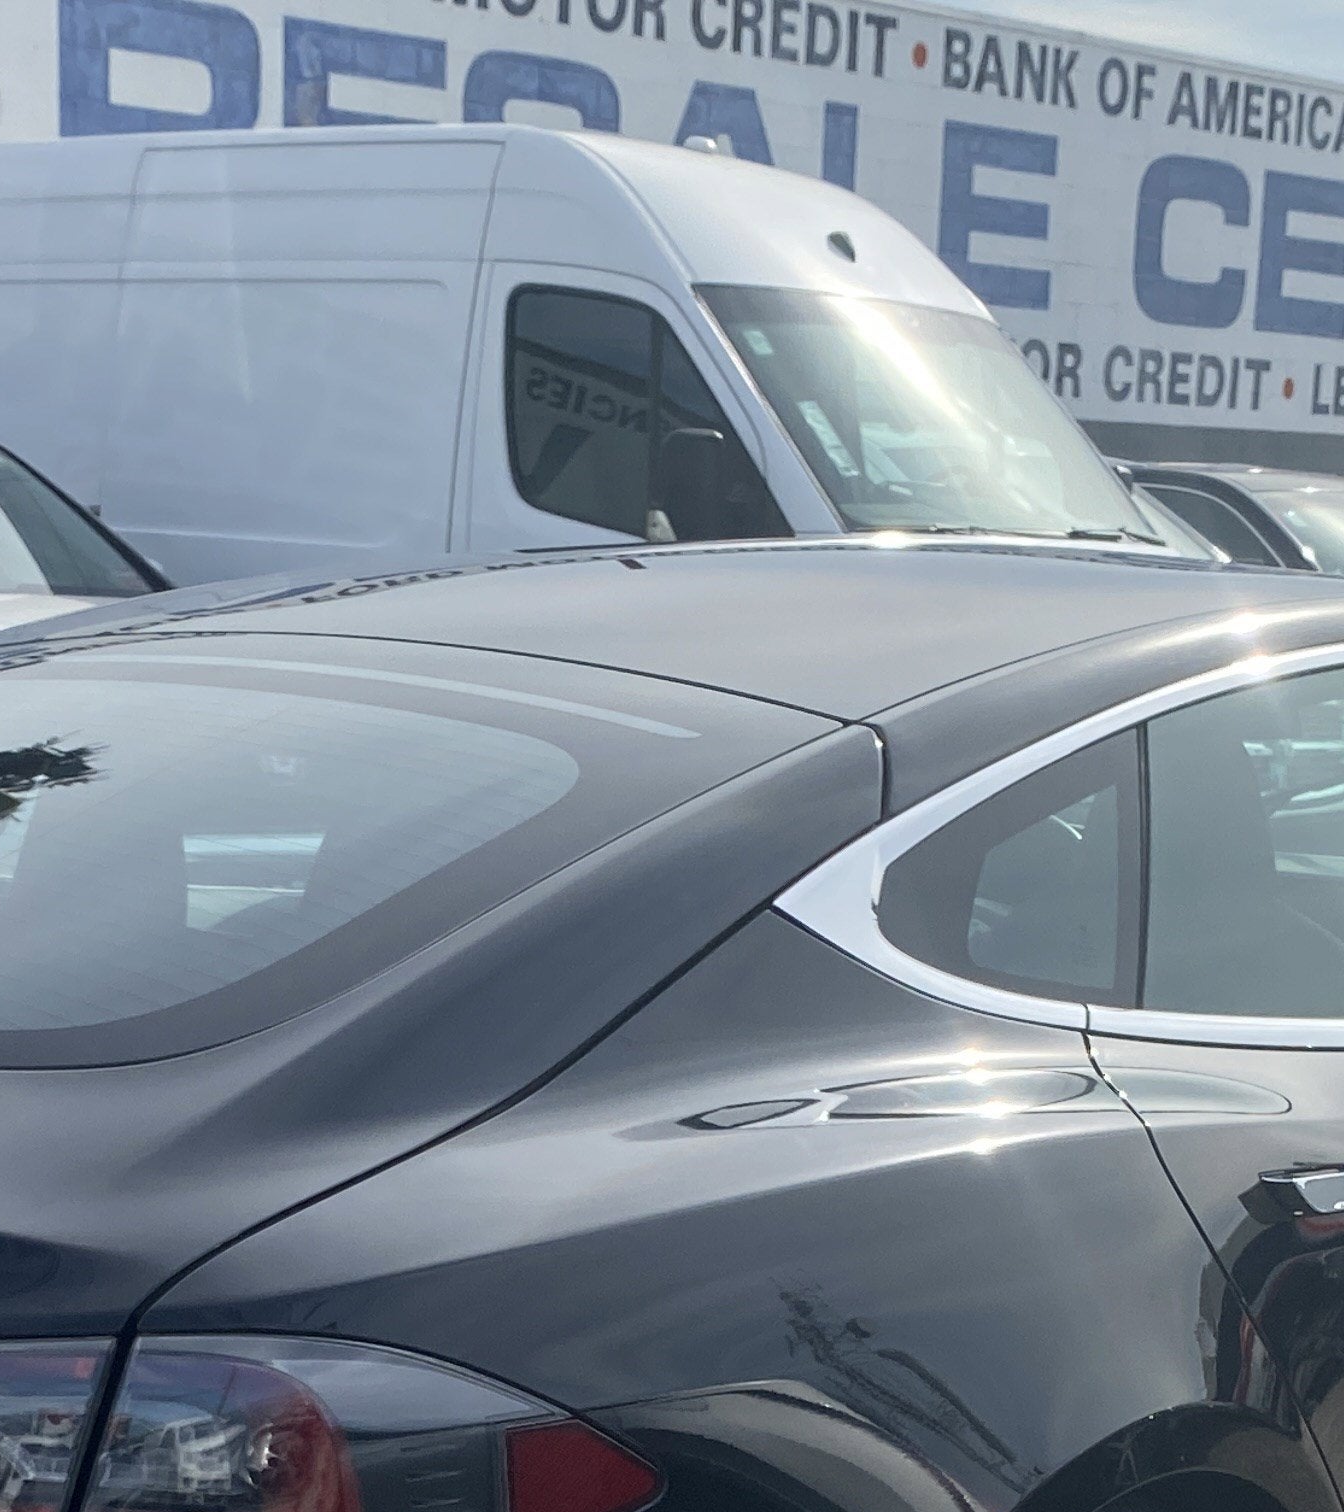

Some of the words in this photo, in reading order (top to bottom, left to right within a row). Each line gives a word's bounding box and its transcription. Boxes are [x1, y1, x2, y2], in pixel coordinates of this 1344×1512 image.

[690, 0, 897, 78] CREDIT
[942, 27, 1079, 109] BANK
[1097, 57, 1157, 119] OF
[1012, 338, 1082, 398] OR
[1103, 345, 1272, 411] CREDIT
